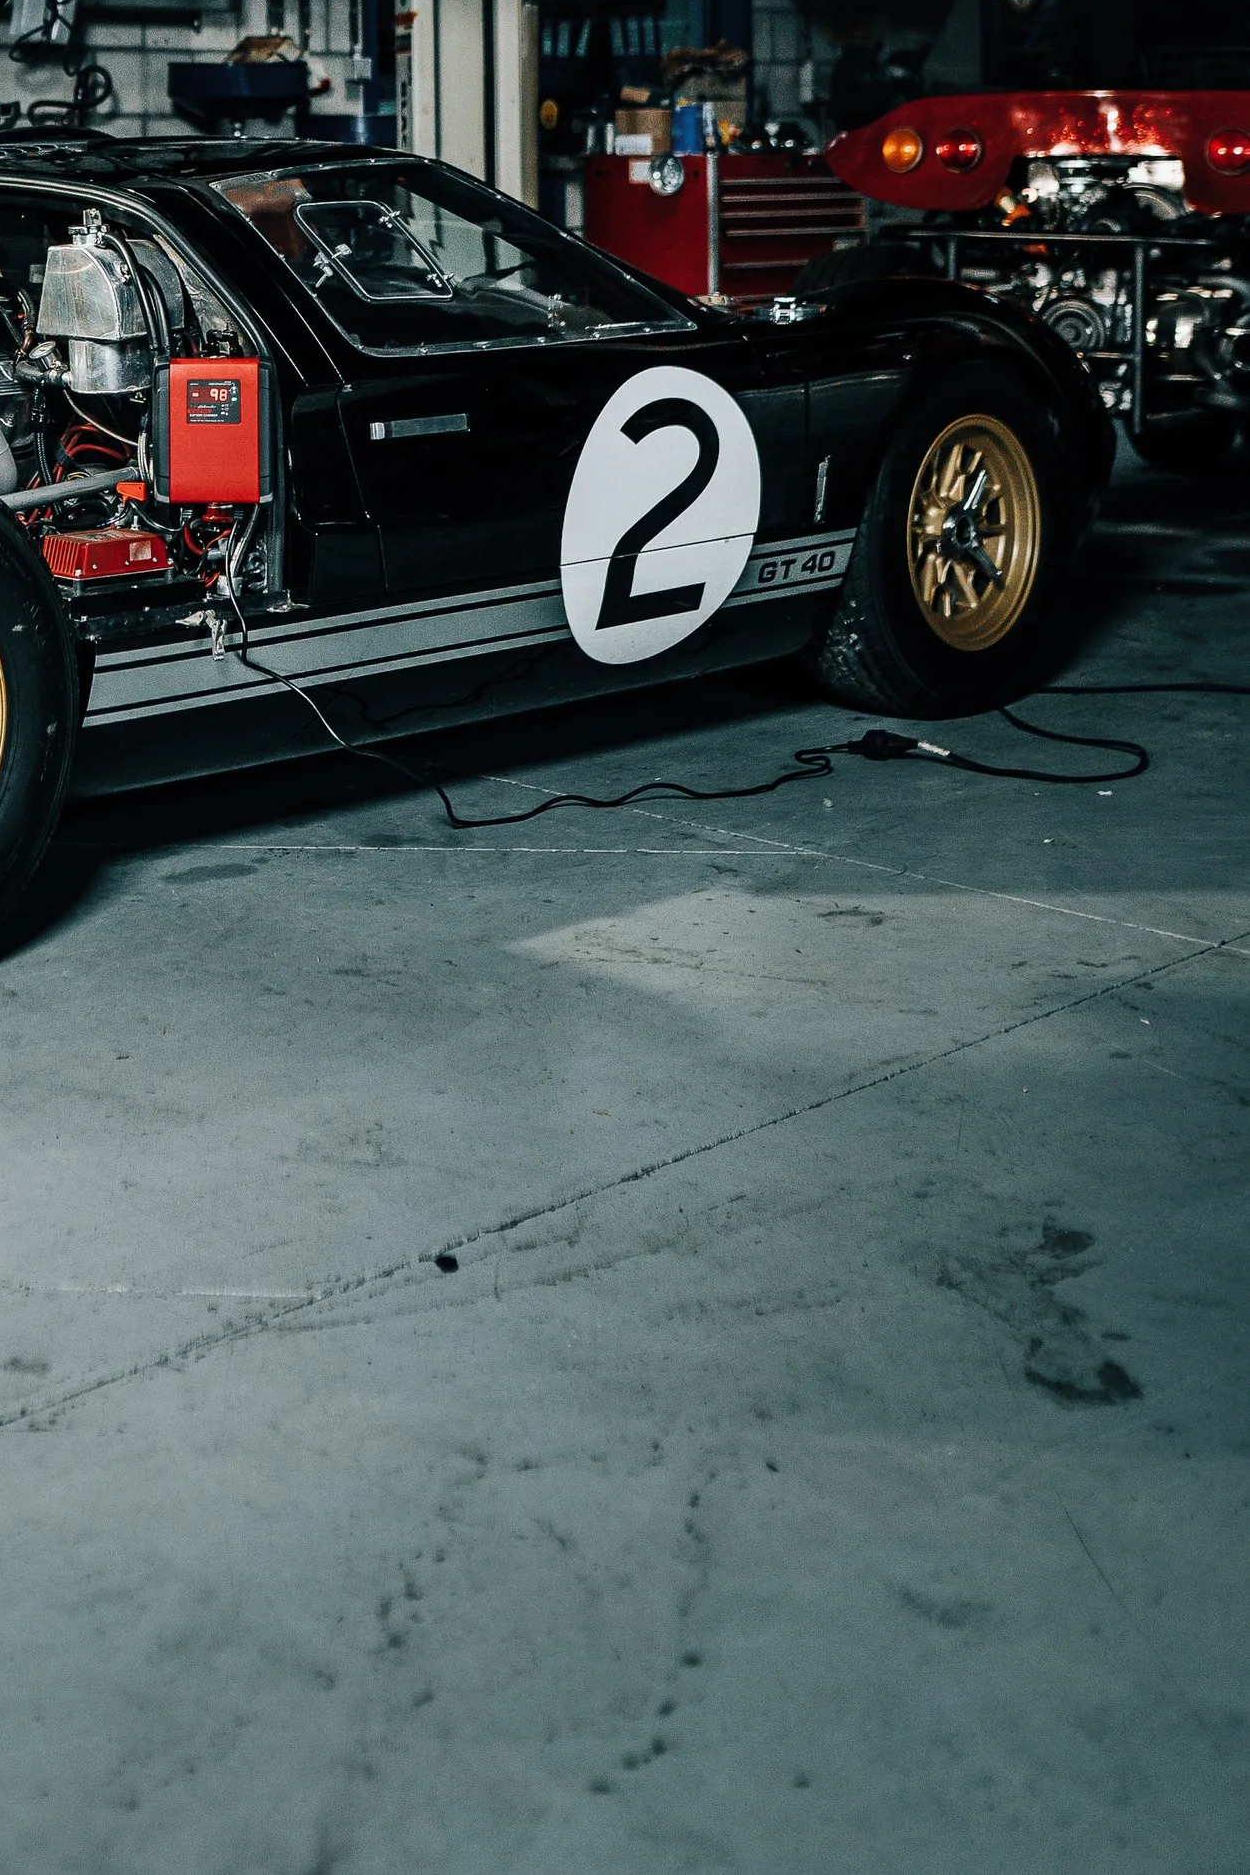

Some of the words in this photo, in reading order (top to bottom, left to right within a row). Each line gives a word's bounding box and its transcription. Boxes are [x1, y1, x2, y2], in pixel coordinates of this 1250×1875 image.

[210, 388, 228, 401] 98
[595, 397, 720, 631] 2
[758, 558, 797, 583] GT
[800, 550, 835, 574] 40
